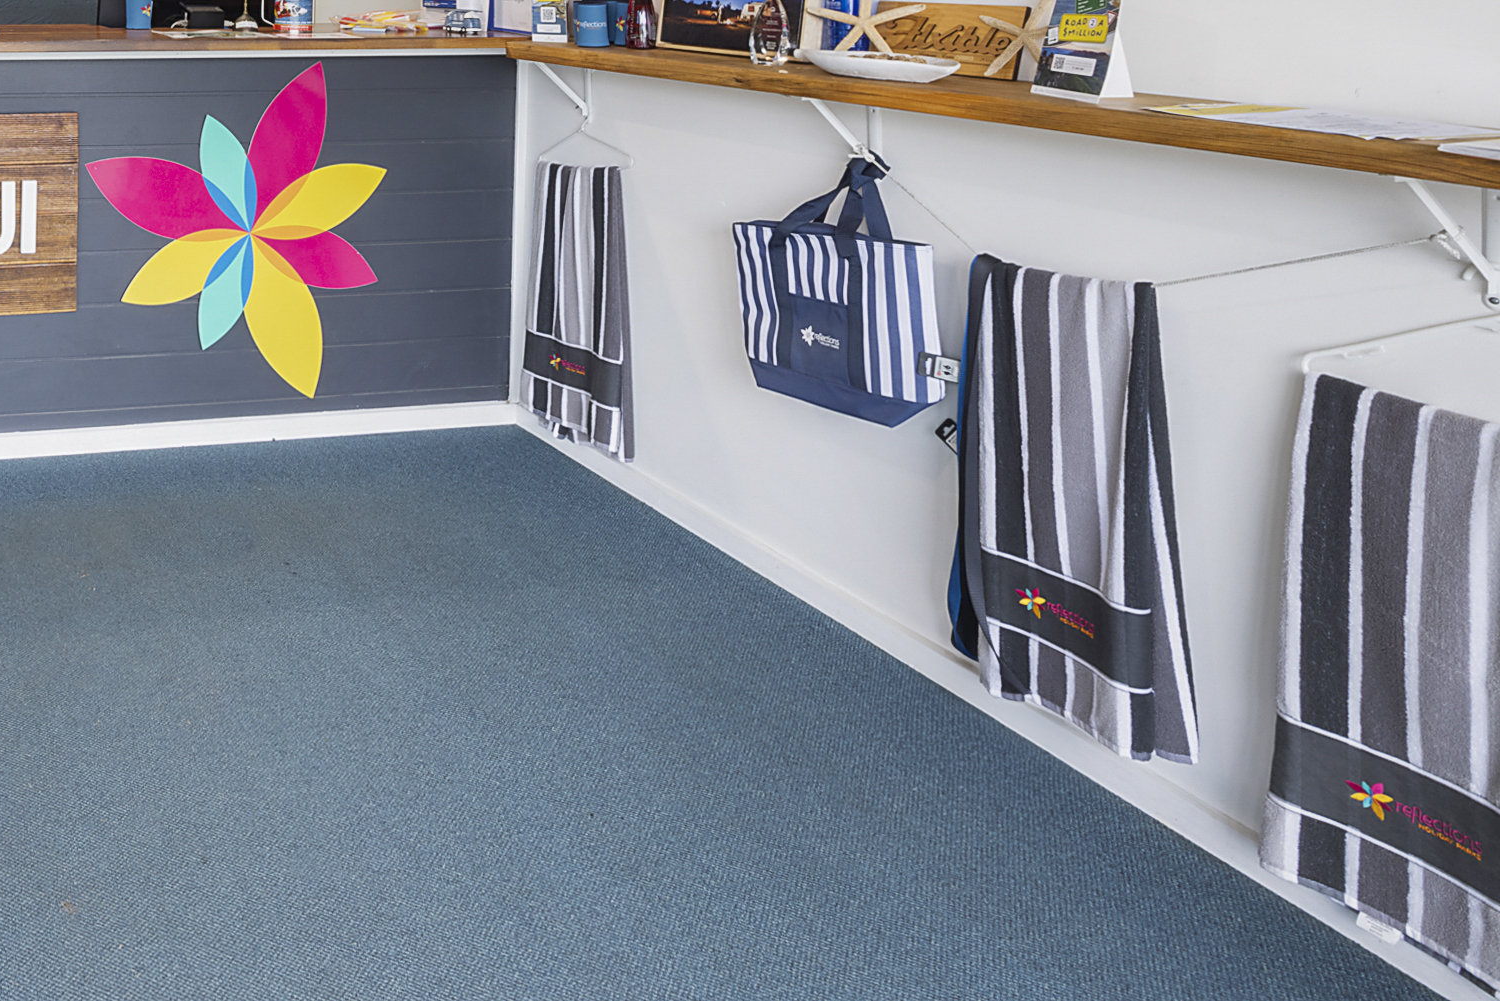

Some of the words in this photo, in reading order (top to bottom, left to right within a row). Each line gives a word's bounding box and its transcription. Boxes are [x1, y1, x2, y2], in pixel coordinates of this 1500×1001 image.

[1065, 17, 1088, 27] ROAD
[1046, 602, 1095, 633] reflections
[1395, 801, 1483, 855] reflections
